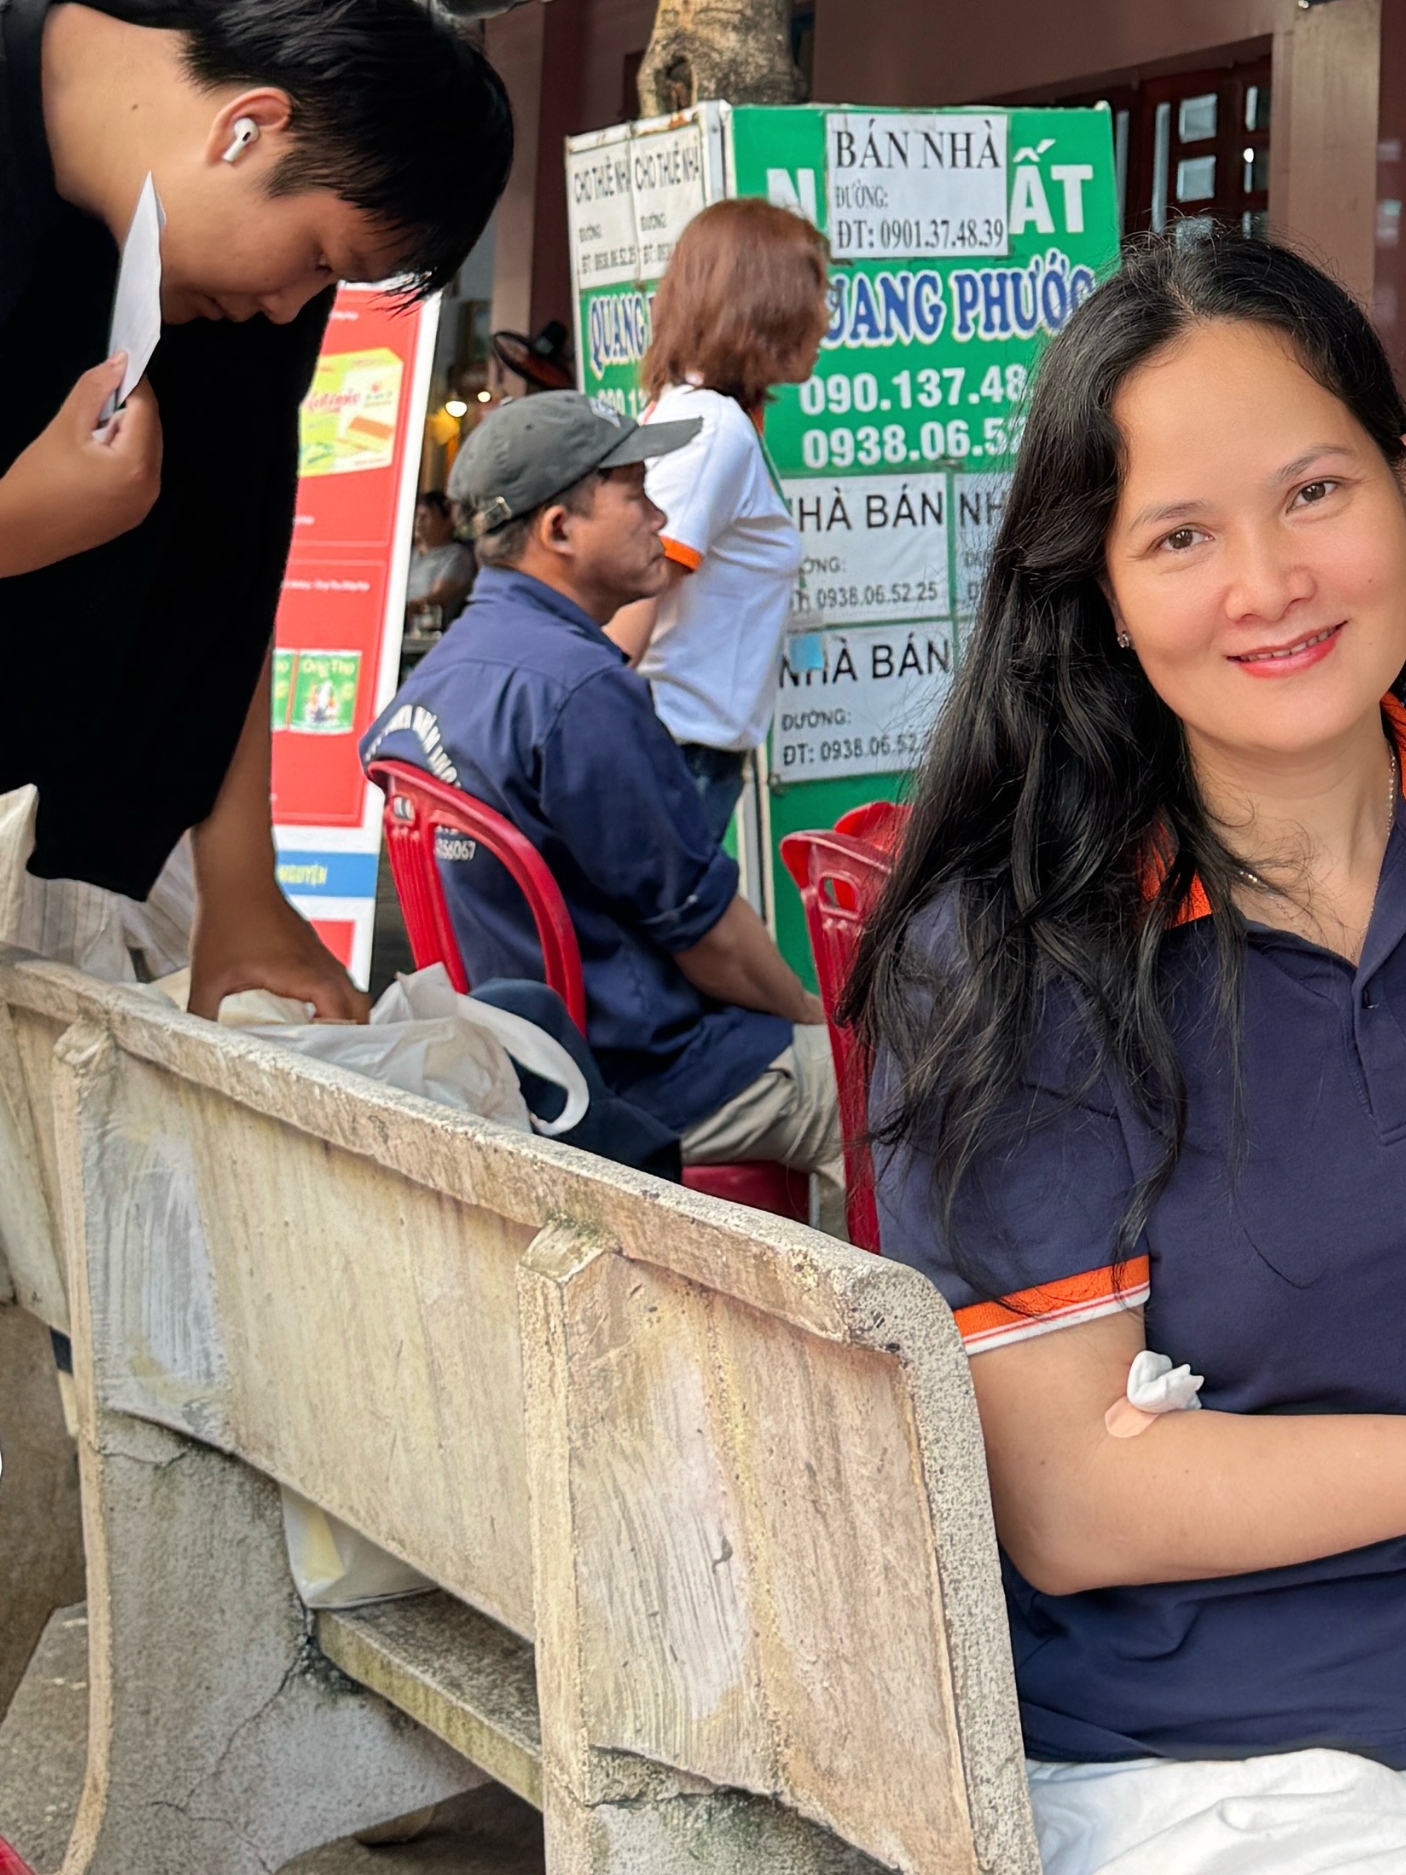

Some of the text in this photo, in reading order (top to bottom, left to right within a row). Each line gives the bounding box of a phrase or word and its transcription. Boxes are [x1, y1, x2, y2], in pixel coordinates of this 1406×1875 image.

[834, 117, 1002, 170] BÁN NHÀ
[1008, 137, 1094, 235] ẤT
[879, 217, 1004, 250] 0901.37.48.39
[825, 270, 946, 345] UANG
[798, 482, 944, 532] HÀ BÁN
[871, 632, 949, 680] BÁN
